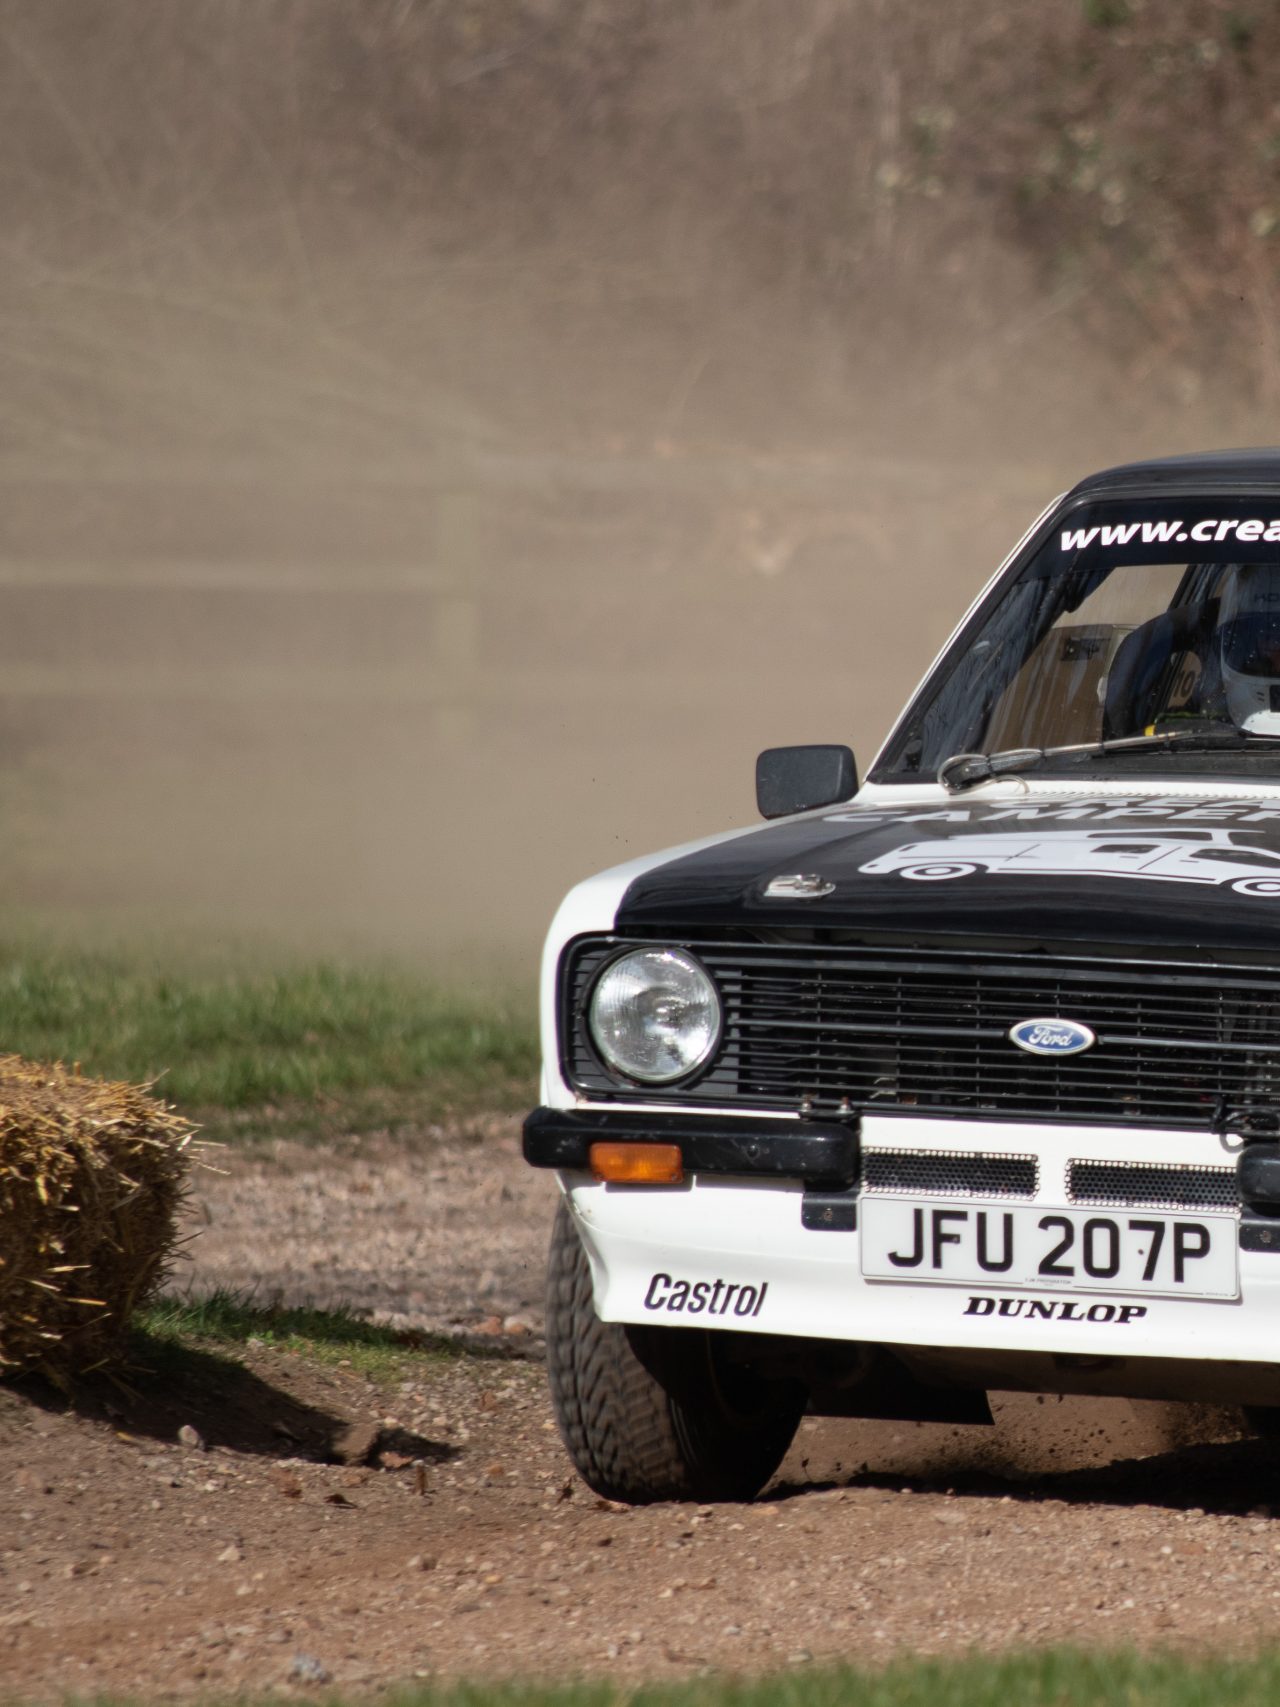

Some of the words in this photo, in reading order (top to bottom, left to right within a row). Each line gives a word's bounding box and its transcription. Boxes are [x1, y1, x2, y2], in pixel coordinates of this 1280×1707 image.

[1028, 1023, 1075, 1047] Ford
[887, 1207, 1015, 1274] JFU
[1036, 1213, 1212, 1284] 207P
[643, 1272, 770, 1317] Castrol
[963, 1296, 1149, 1324] DUNLOP
